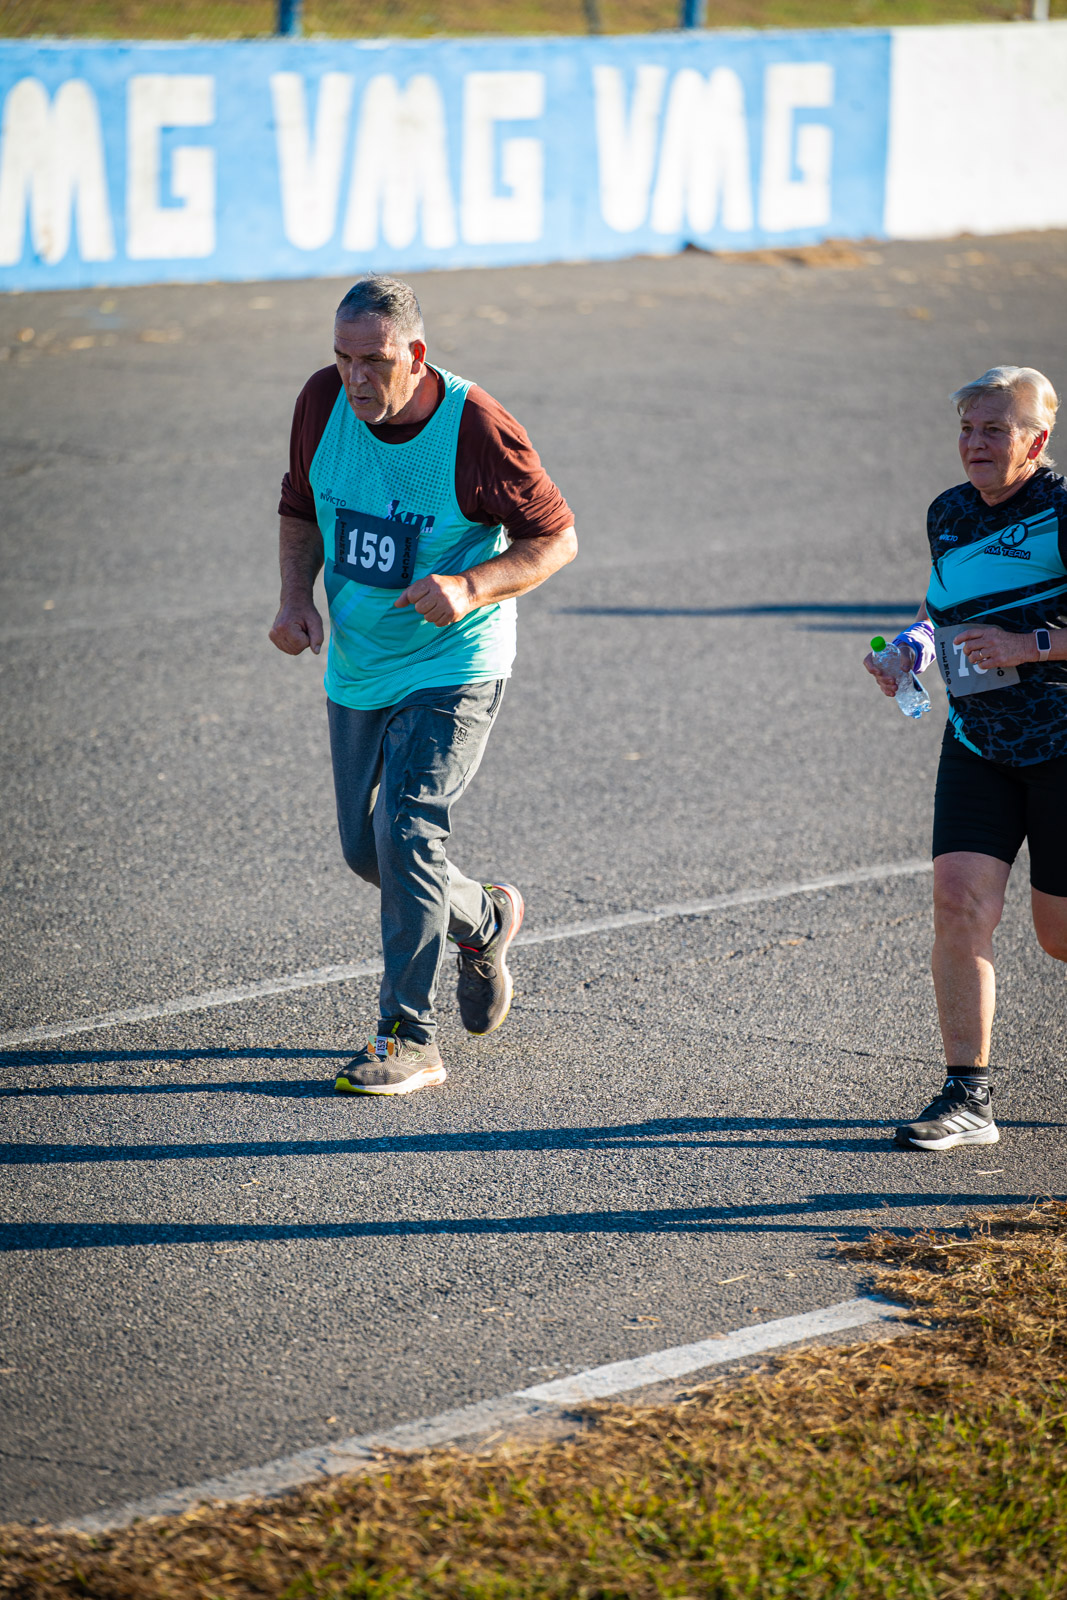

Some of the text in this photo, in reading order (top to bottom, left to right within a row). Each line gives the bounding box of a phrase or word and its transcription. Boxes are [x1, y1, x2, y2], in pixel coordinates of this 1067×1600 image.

[270, 70, 545, 251] VMG
[593, 62, 834, 234] VMG
[346, 528, 396, 573] 159
[401, 537, 412, 579] EXACTO
[1002, 548, 1031, 560] TEAM
[940, 641, 952, 685] TIEMPO
[952, 640, 989, 678] 7
